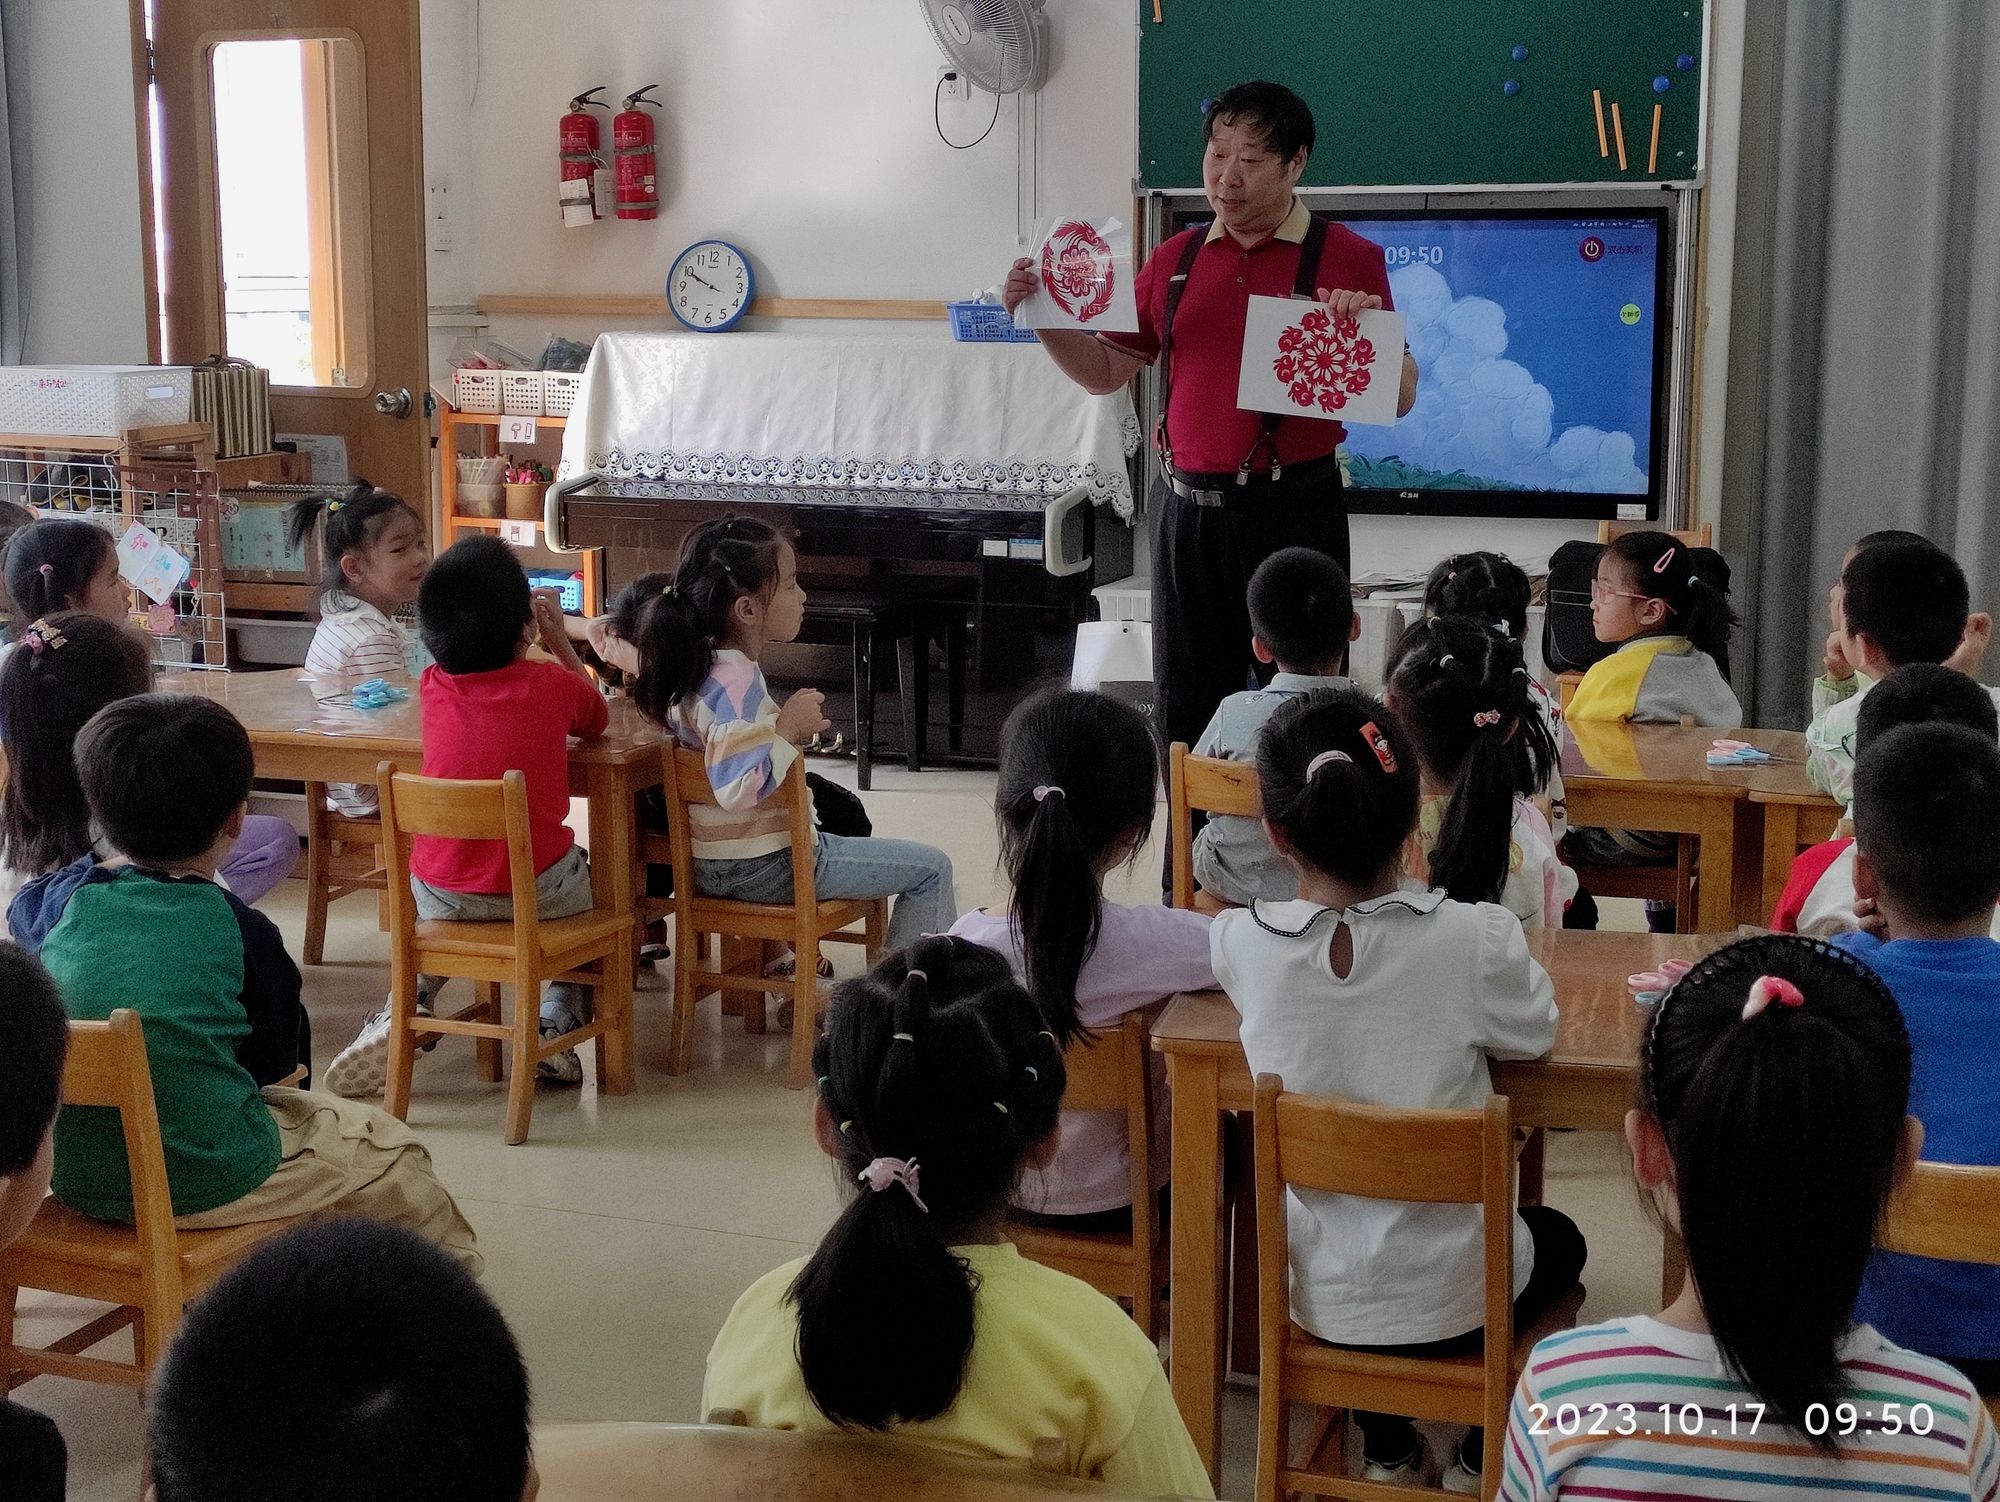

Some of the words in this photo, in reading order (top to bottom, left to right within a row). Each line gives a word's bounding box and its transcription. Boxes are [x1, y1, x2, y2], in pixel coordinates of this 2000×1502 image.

[697, 255, 705, 266] 11
[709, 251, 720, 263] 12
[1384, 245, 1443, 265] 09:50
[684, 266, 694, 277] 10
[735, 267, 743, 279] 2
[679, 281, 687, 292] 9
[736, 283, 744, 294] 3
[680, 296, 688, 308] 8
[731, 299, 739, 308] 4
[691, 308, 699, 319] 7
[704, 312, 712, 324] 6
[719, 309, 727, 320] 5
